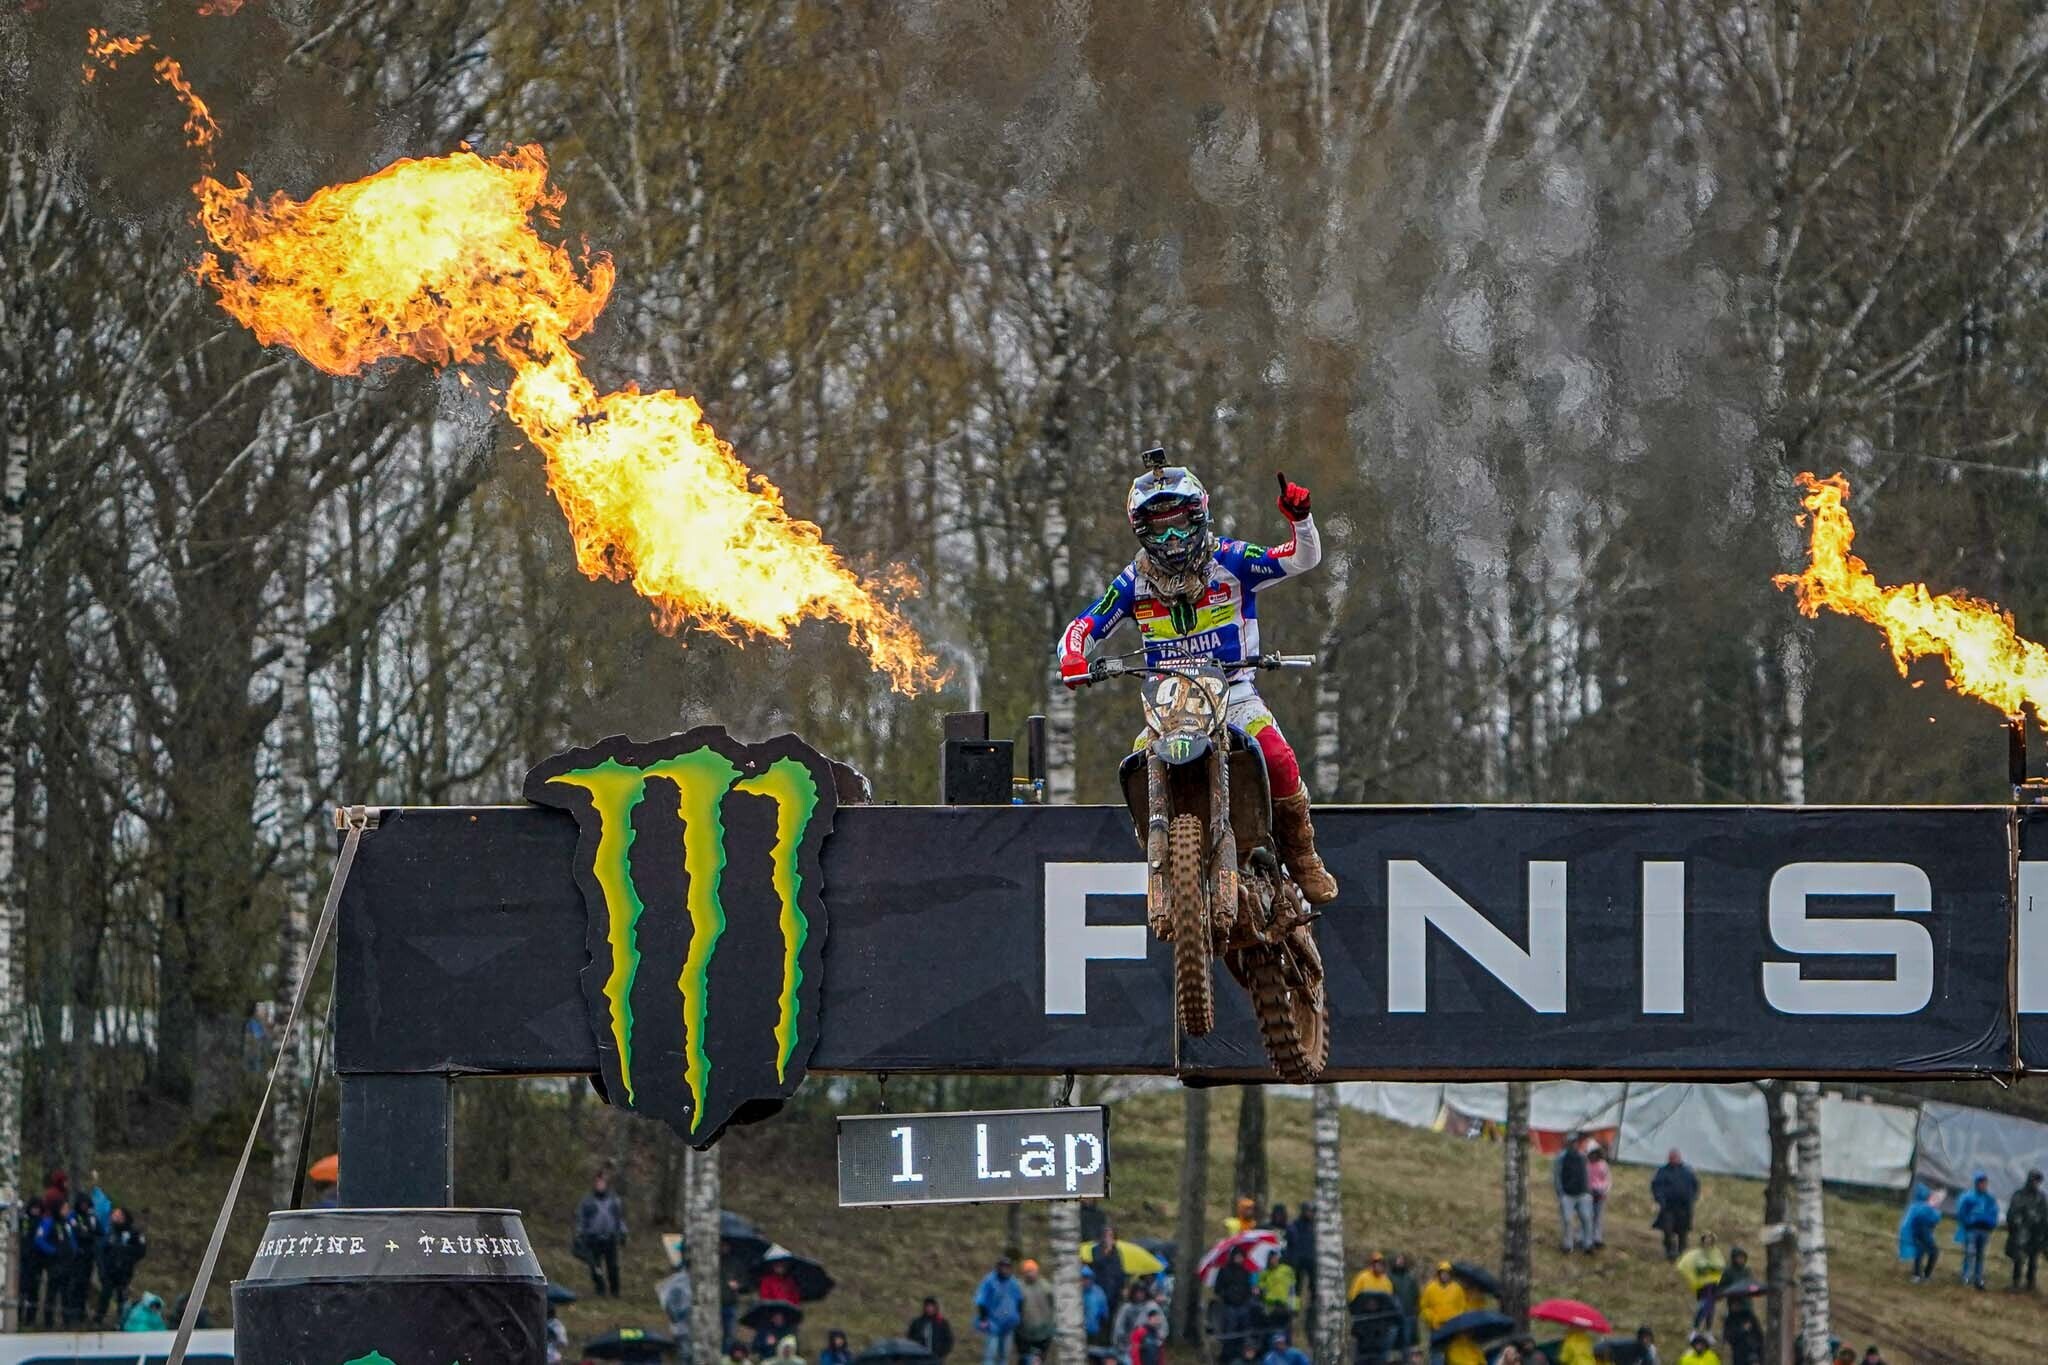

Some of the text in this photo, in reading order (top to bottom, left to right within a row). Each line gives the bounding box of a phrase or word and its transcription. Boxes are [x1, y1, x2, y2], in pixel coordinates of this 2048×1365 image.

[1044, 858, 2048, 1015] FNIS
[891, 1123, 1102, 1191] 1 Lap
